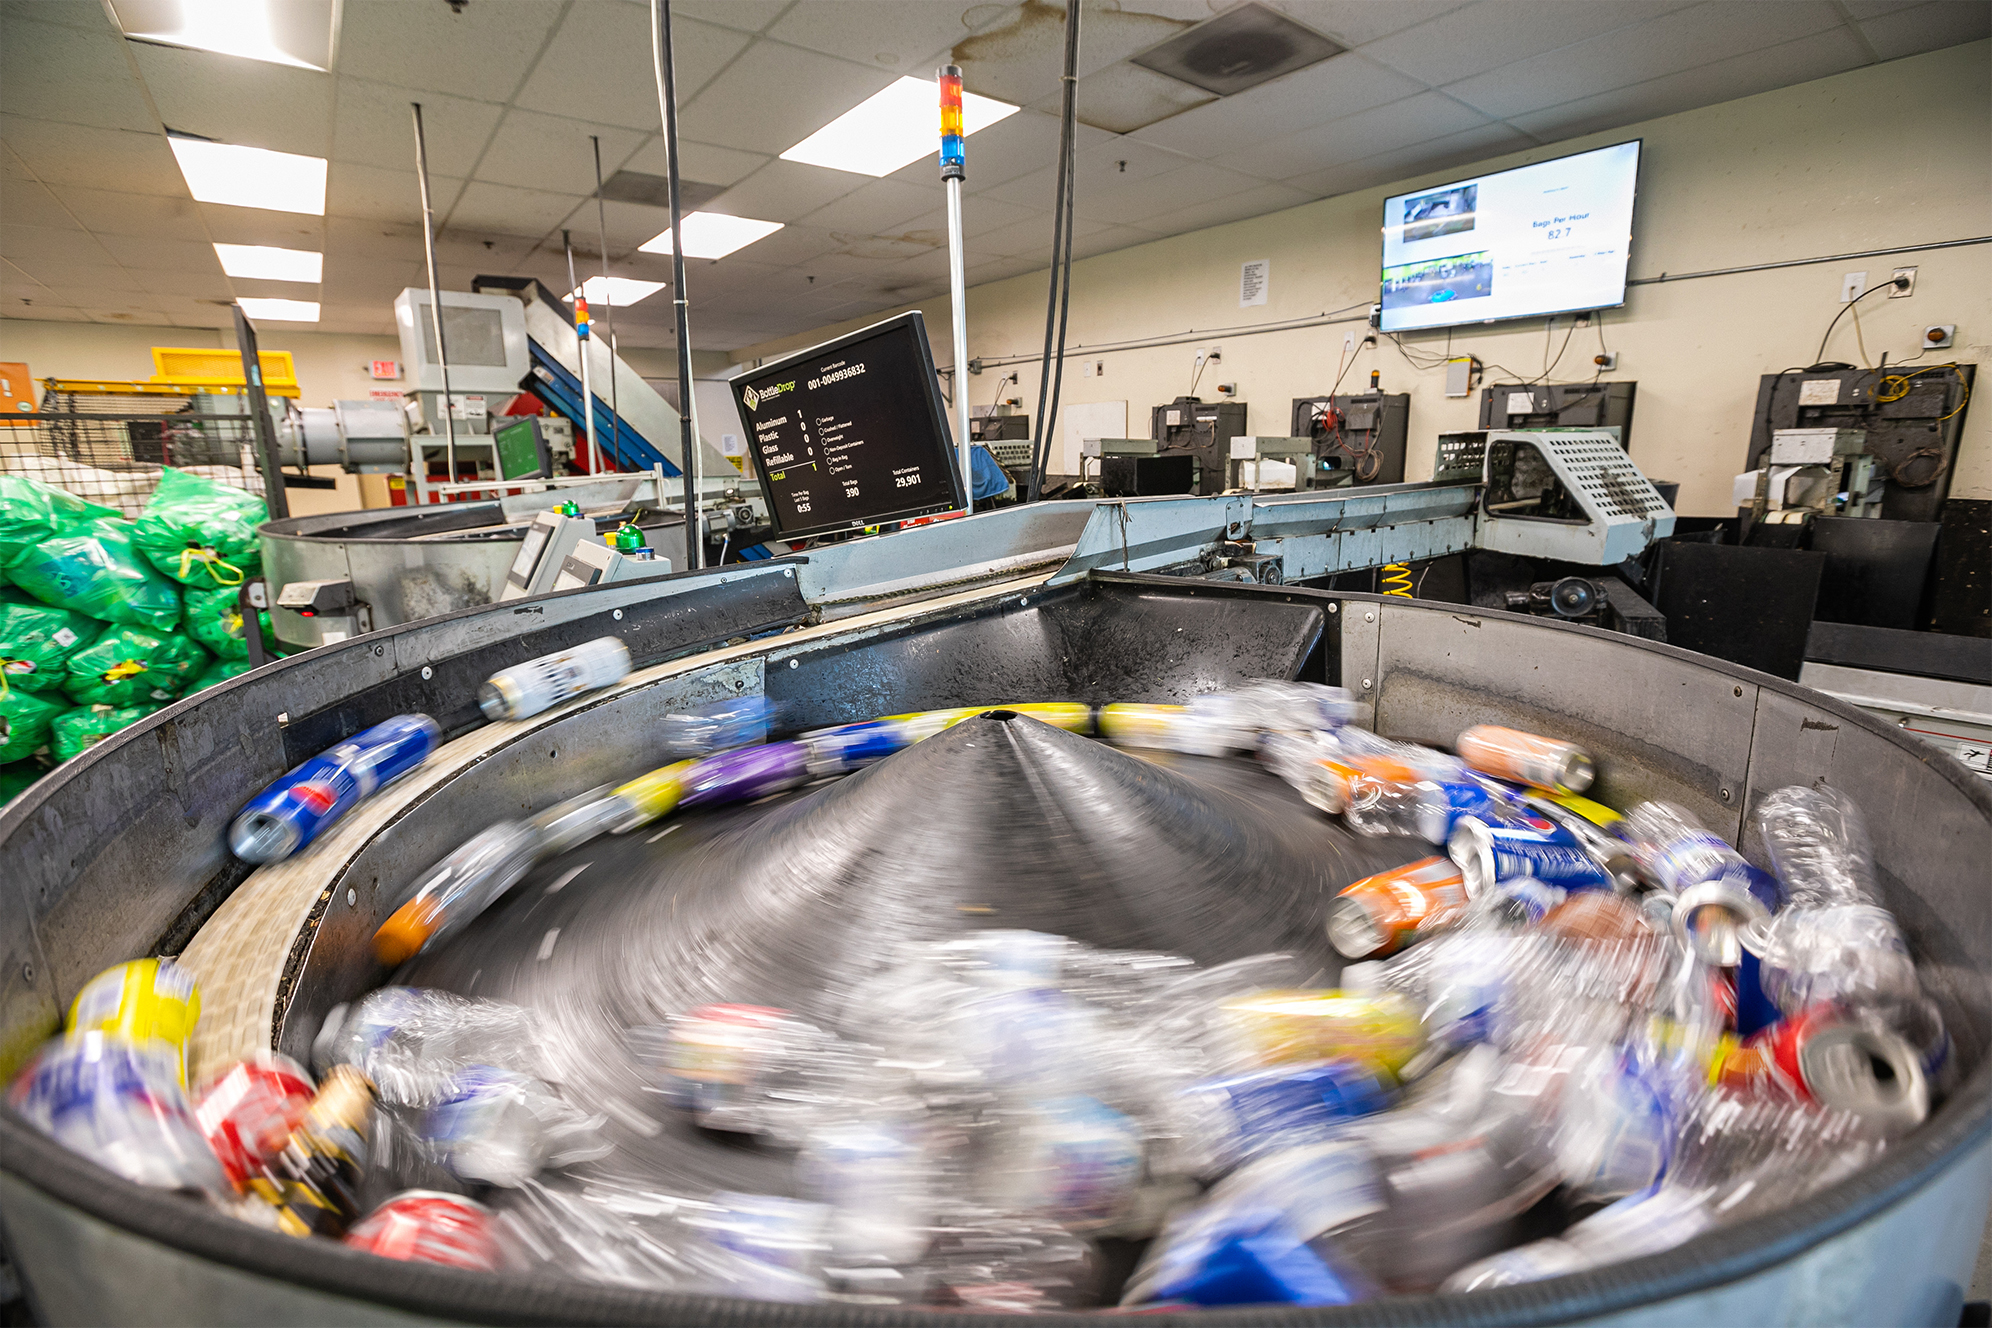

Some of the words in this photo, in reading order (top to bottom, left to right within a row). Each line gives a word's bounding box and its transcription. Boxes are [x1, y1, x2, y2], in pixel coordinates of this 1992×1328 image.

[1547, 227, 1572, 240] 827
[807, 363, 866, 391] 001-0049936832
[759, 380, 796, 399] BottleDrop
[755, 416, 788, 432] Aluminum
[797, 409, 803, 419] 1
[758, 430, 779, 443] Plastic
[800, 421, 807, 431] 0
[762, 444, 779, 455] Glass
[803, 433, 810, 444] 0
[765, 452, 795, 467] Refillable
[807, 446, 814, 456] 0
[769, 470, 786, 482] Total
[812, 462, 818, 472] 1
[895, 473, 922, 488] 29,901
[845, 487, 860, 498] 390
[797, 502, 812, 513] 0:55
